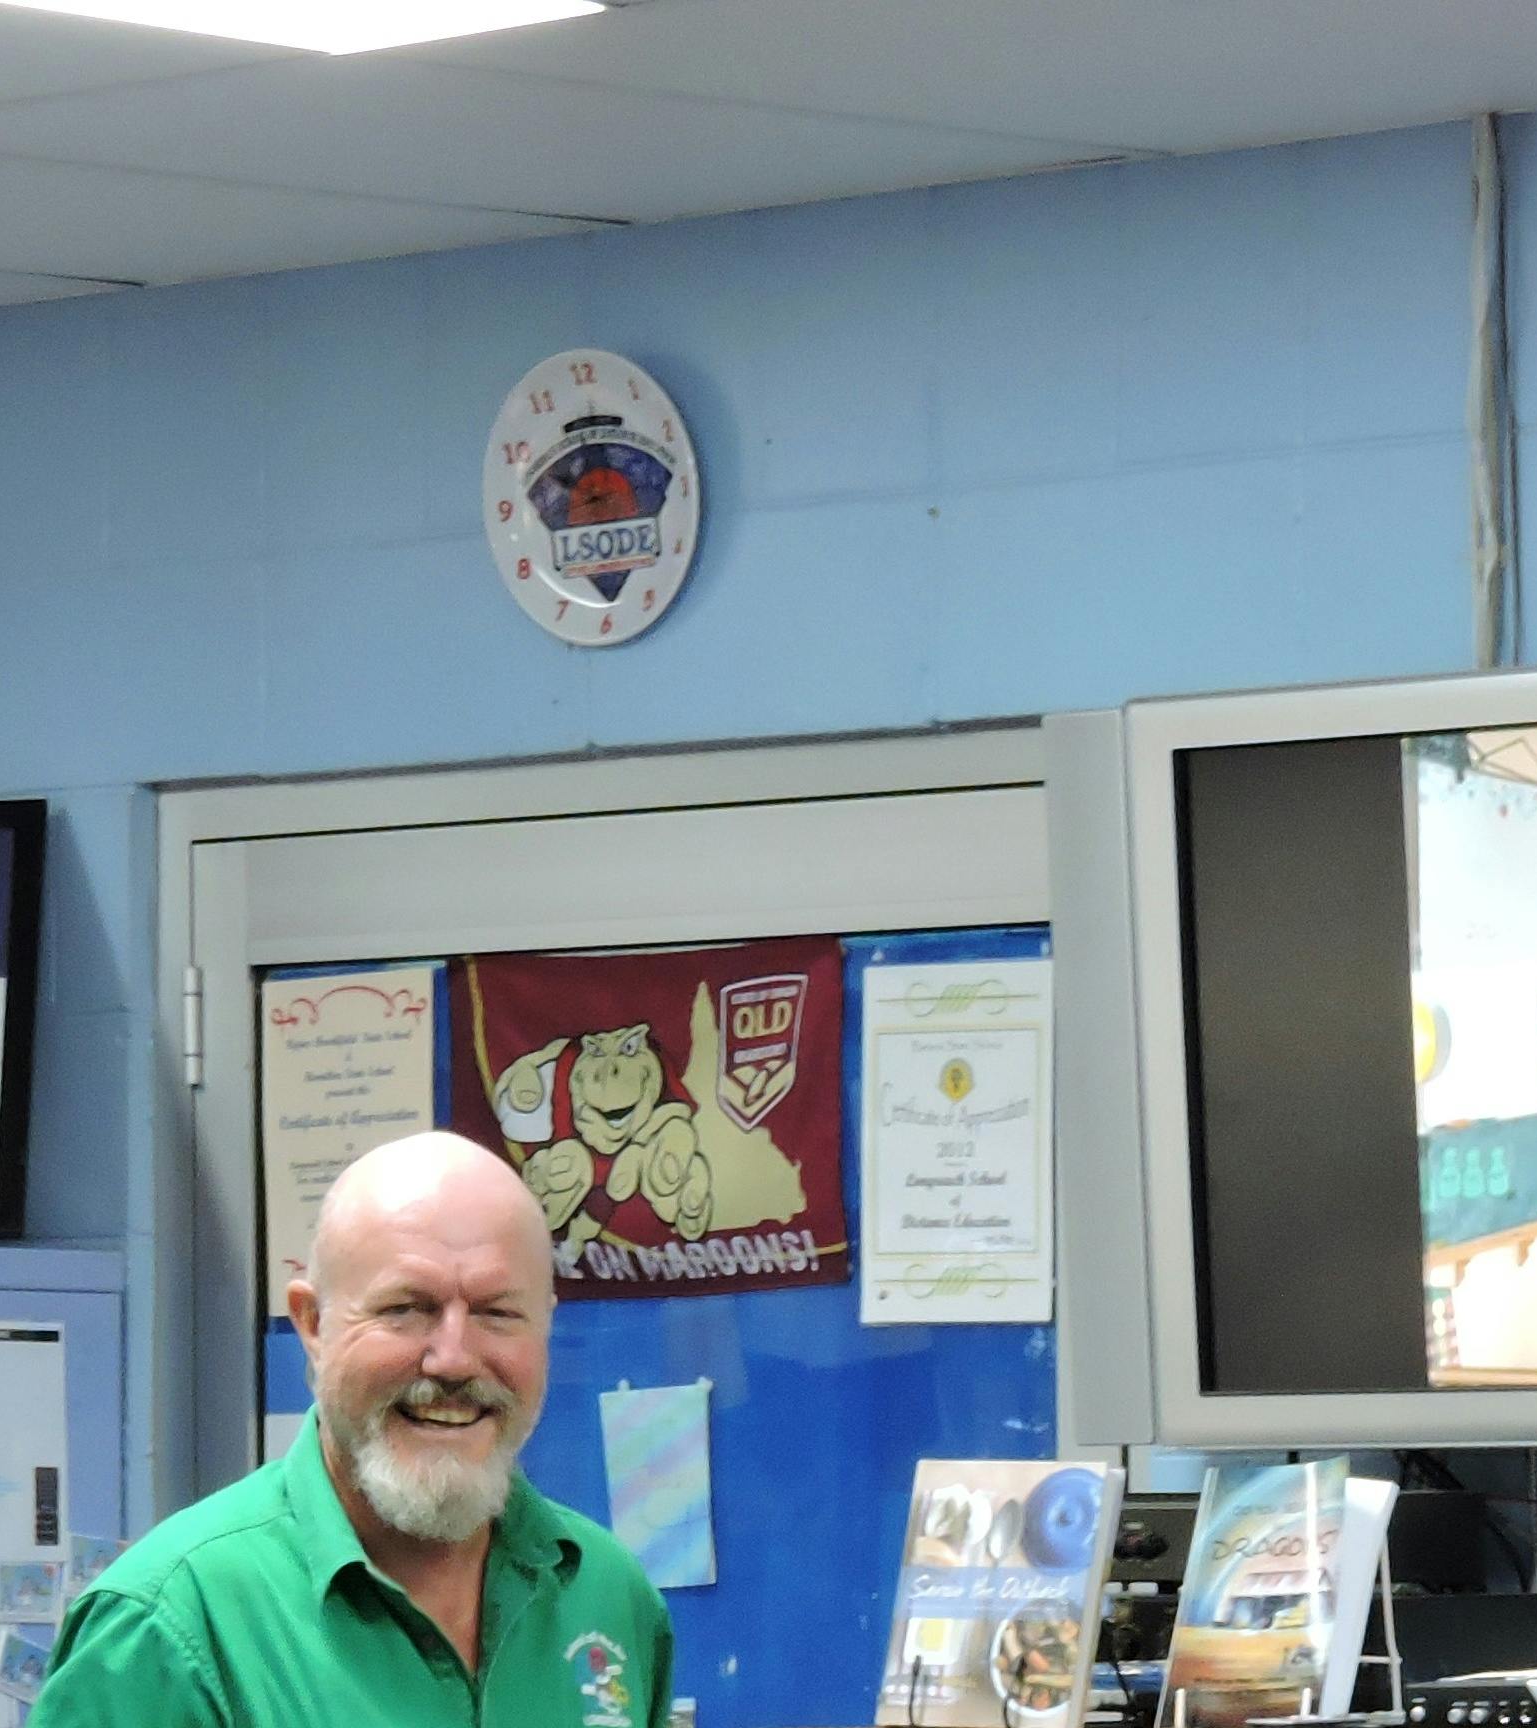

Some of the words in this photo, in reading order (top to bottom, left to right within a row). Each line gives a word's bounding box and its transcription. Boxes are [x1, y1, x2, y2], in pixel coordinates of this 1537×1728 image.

[569, 361, 598, 386] 12
[561, 524, 657, 562] LSODE
[733, 1001, 793, 1039] QLD
